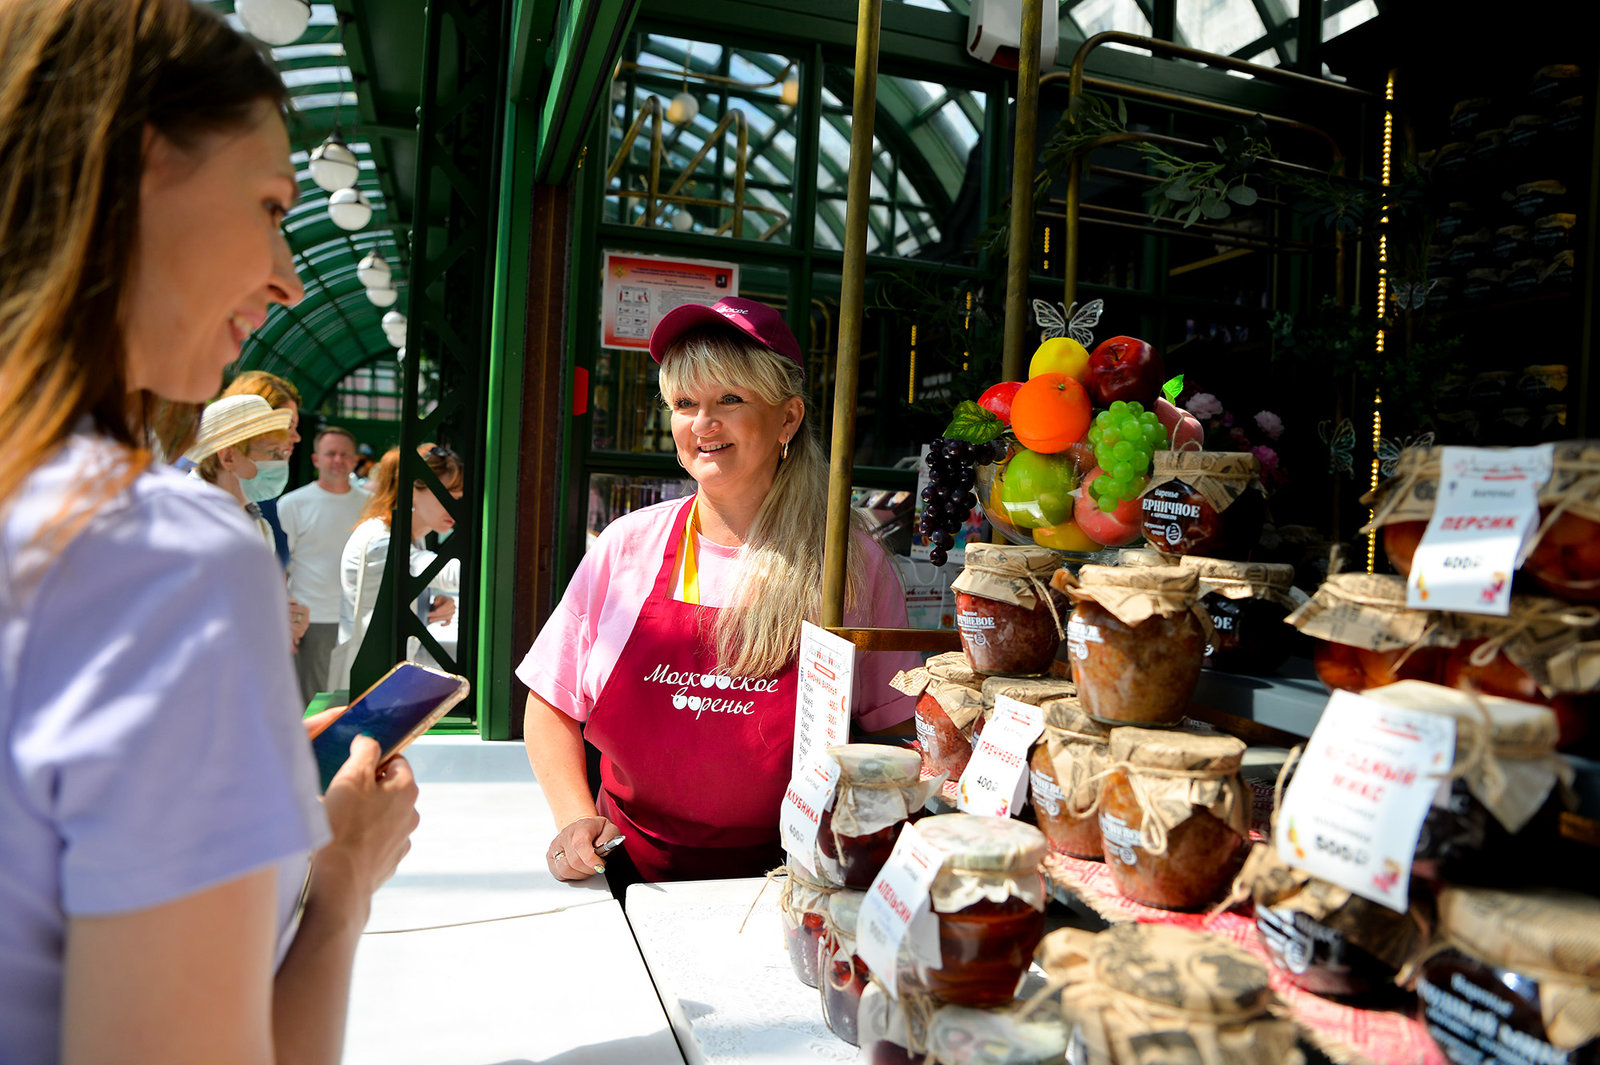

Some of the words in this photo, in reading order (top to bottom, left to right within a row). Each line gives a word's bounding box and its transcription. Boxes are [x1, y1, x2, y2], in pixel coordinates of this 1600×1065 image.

[1141, 498, 1201, 518] ЕРНИЧНОЕ
[1440, 515, 1520, 531] ПЕРСИК
[643, 662, 779, 693] Московское
[670, 687, 755, 720] варенье
[787, 788, 819, 824] КЛУБНИКА
